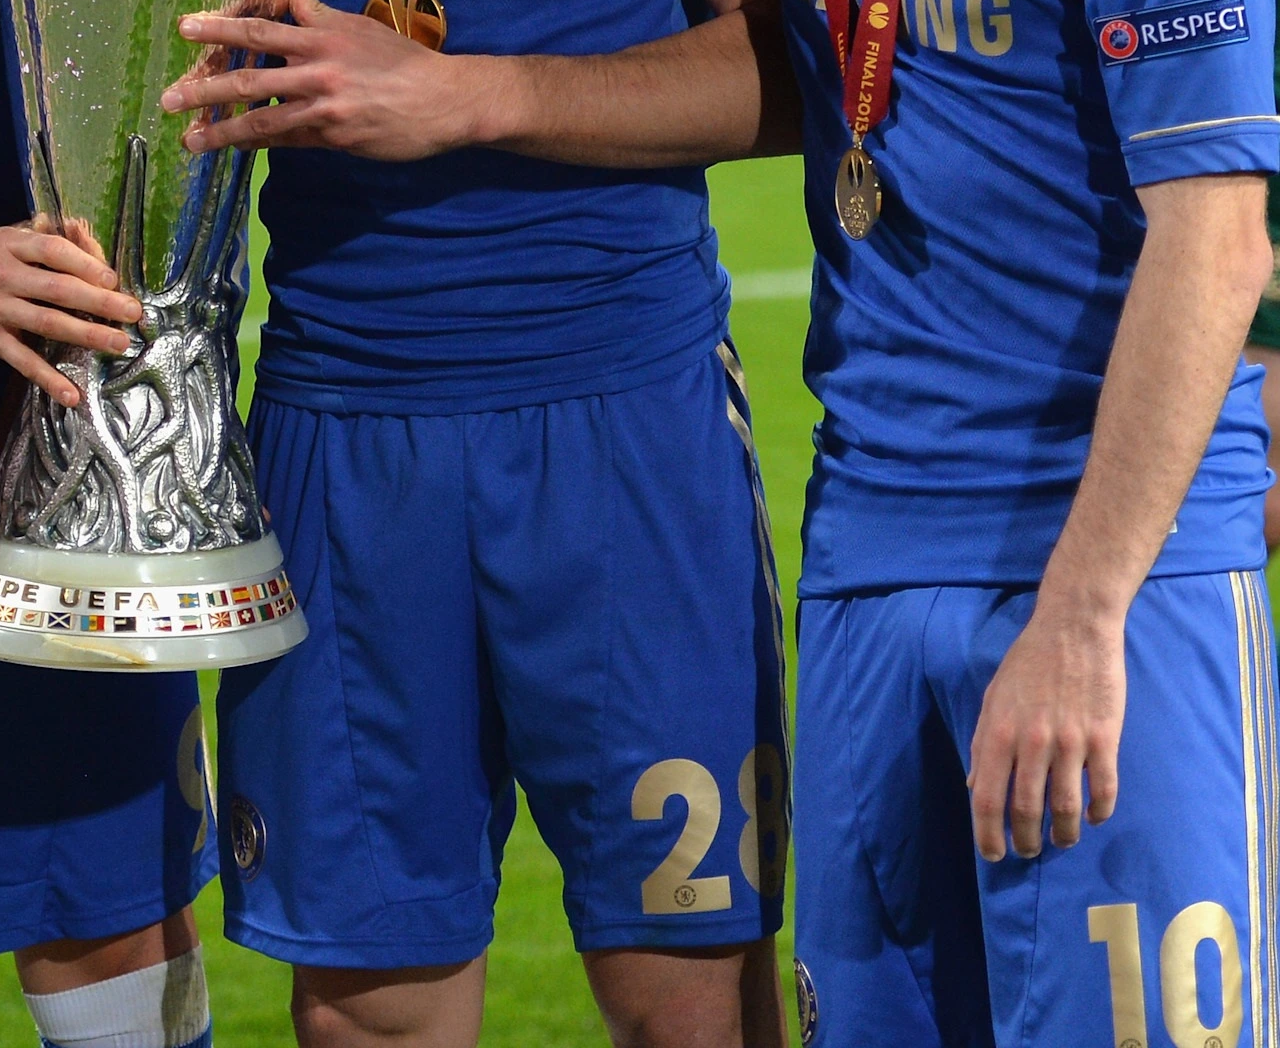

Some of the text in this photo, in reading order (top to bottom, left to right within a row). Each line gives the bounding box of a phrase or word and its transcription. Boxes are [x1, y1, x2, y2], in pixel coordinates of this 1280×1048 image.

[1105, 21, 1129, 33] UEFA
[1141, 6, 1246, 46] RESPECT
[854, 41, 881, 133] FINAL 2013
[59, 589, 160, 612] UEFA
[631, 743, 786, 915] 28
[1087, 901, 1243, 1048] 10
